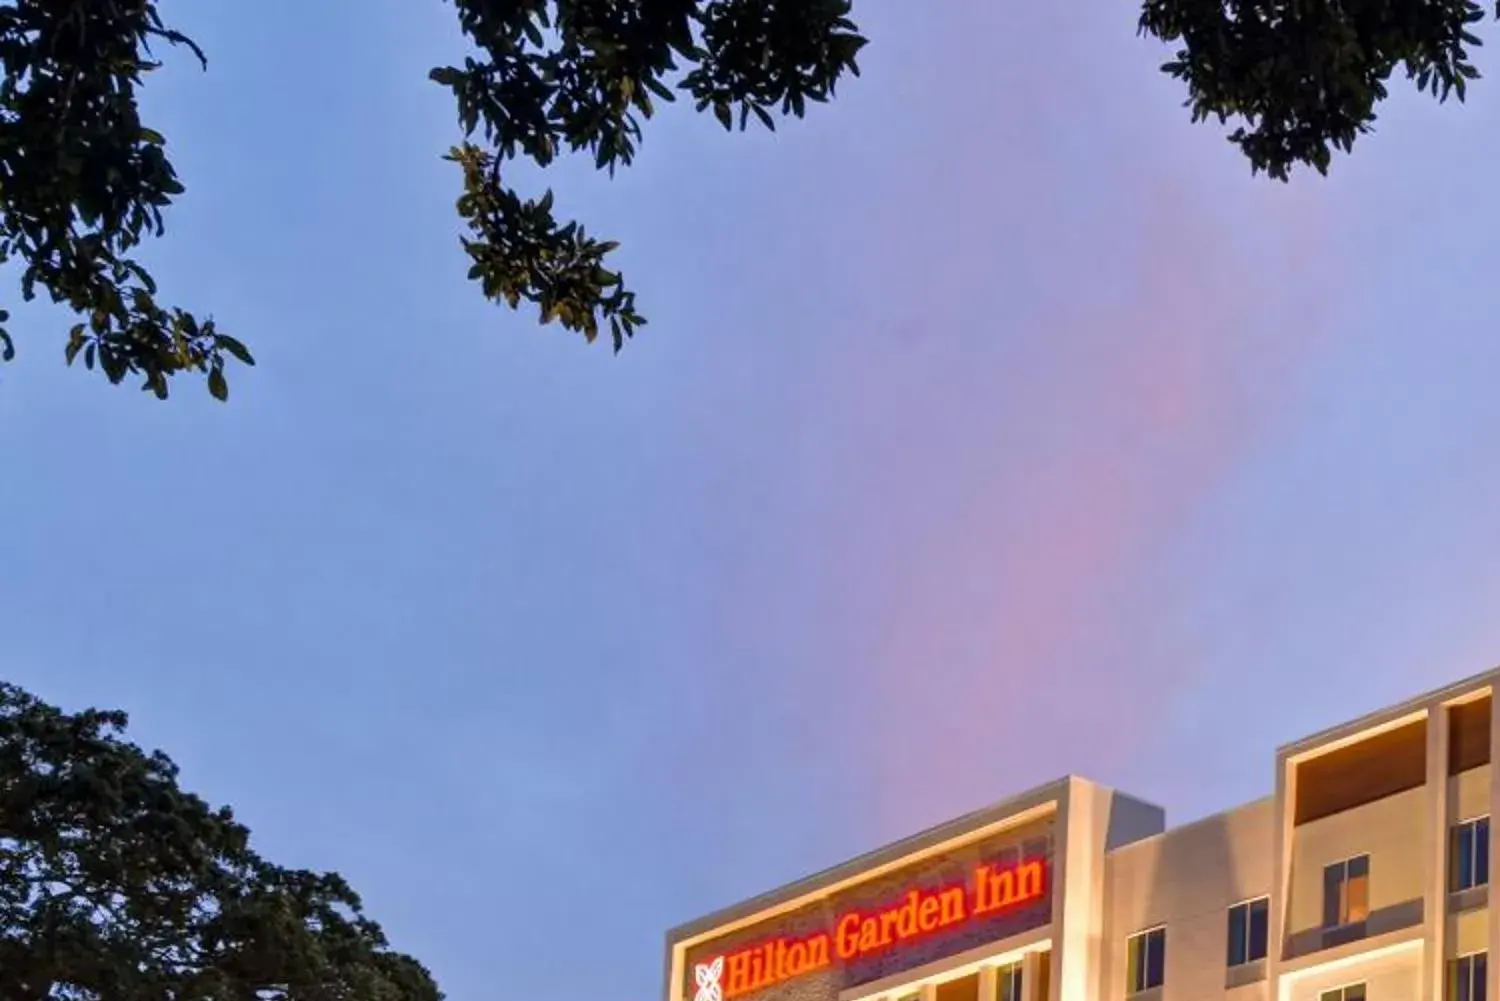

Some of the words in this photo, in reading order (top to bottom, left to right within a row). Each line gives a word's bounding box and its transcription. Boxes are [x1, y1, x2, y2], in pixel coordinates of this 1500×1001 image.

[725, 934, 830, 998] Hilton
[836, 886, 966, 958] Garden
[973, 860, 1045, 914] Inn
